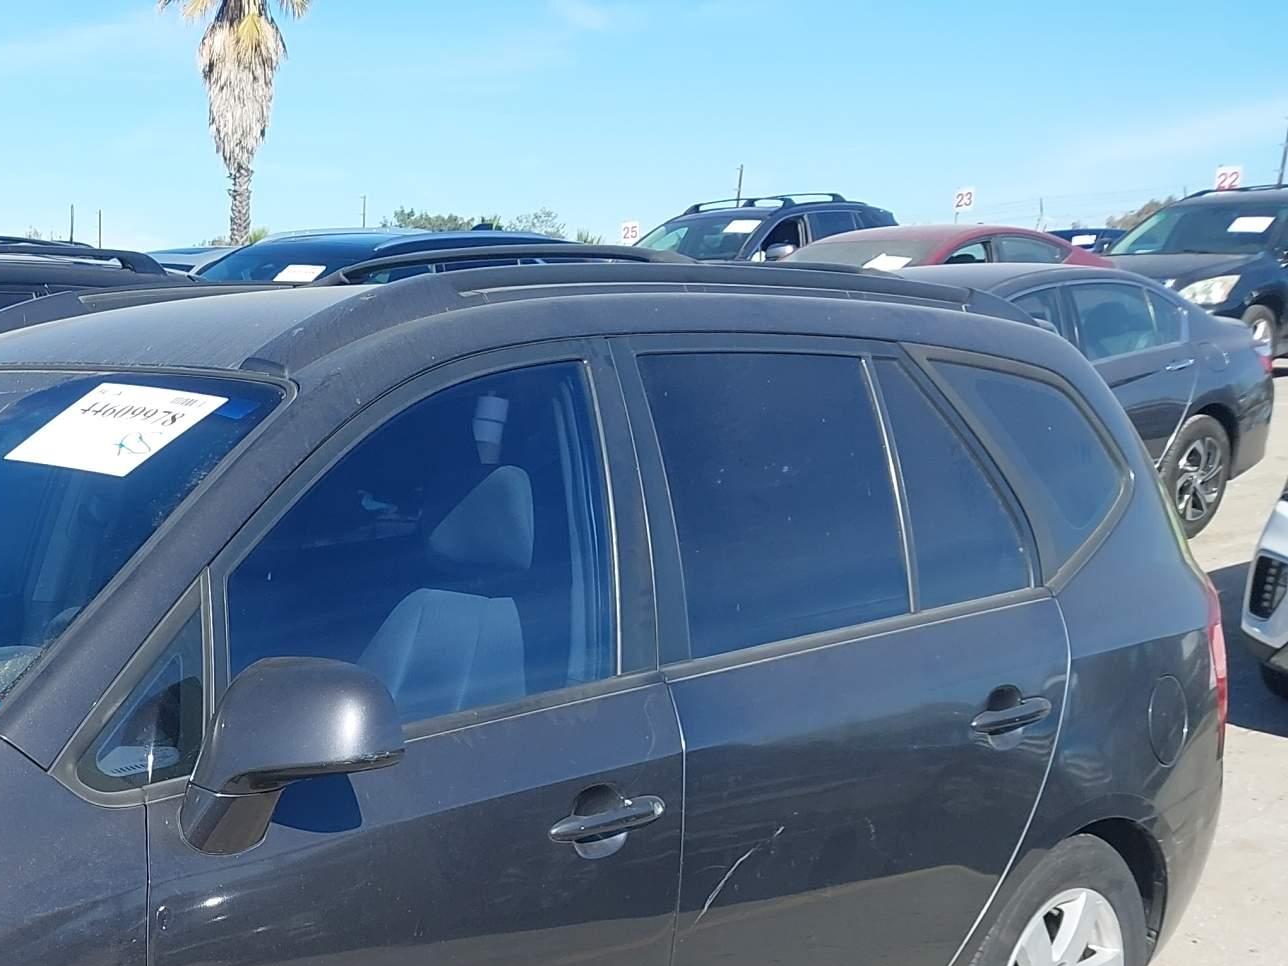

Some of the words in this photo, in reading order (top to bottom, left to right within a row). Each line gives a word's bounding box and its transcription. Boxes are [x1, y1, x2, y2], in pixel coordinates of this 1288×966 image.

[1217, 170, 1240, 190] 22
[956, 191, 973, 208] 23
[623, 225, 638, 239] 25
[80, 401, 186, 427] 44609978
